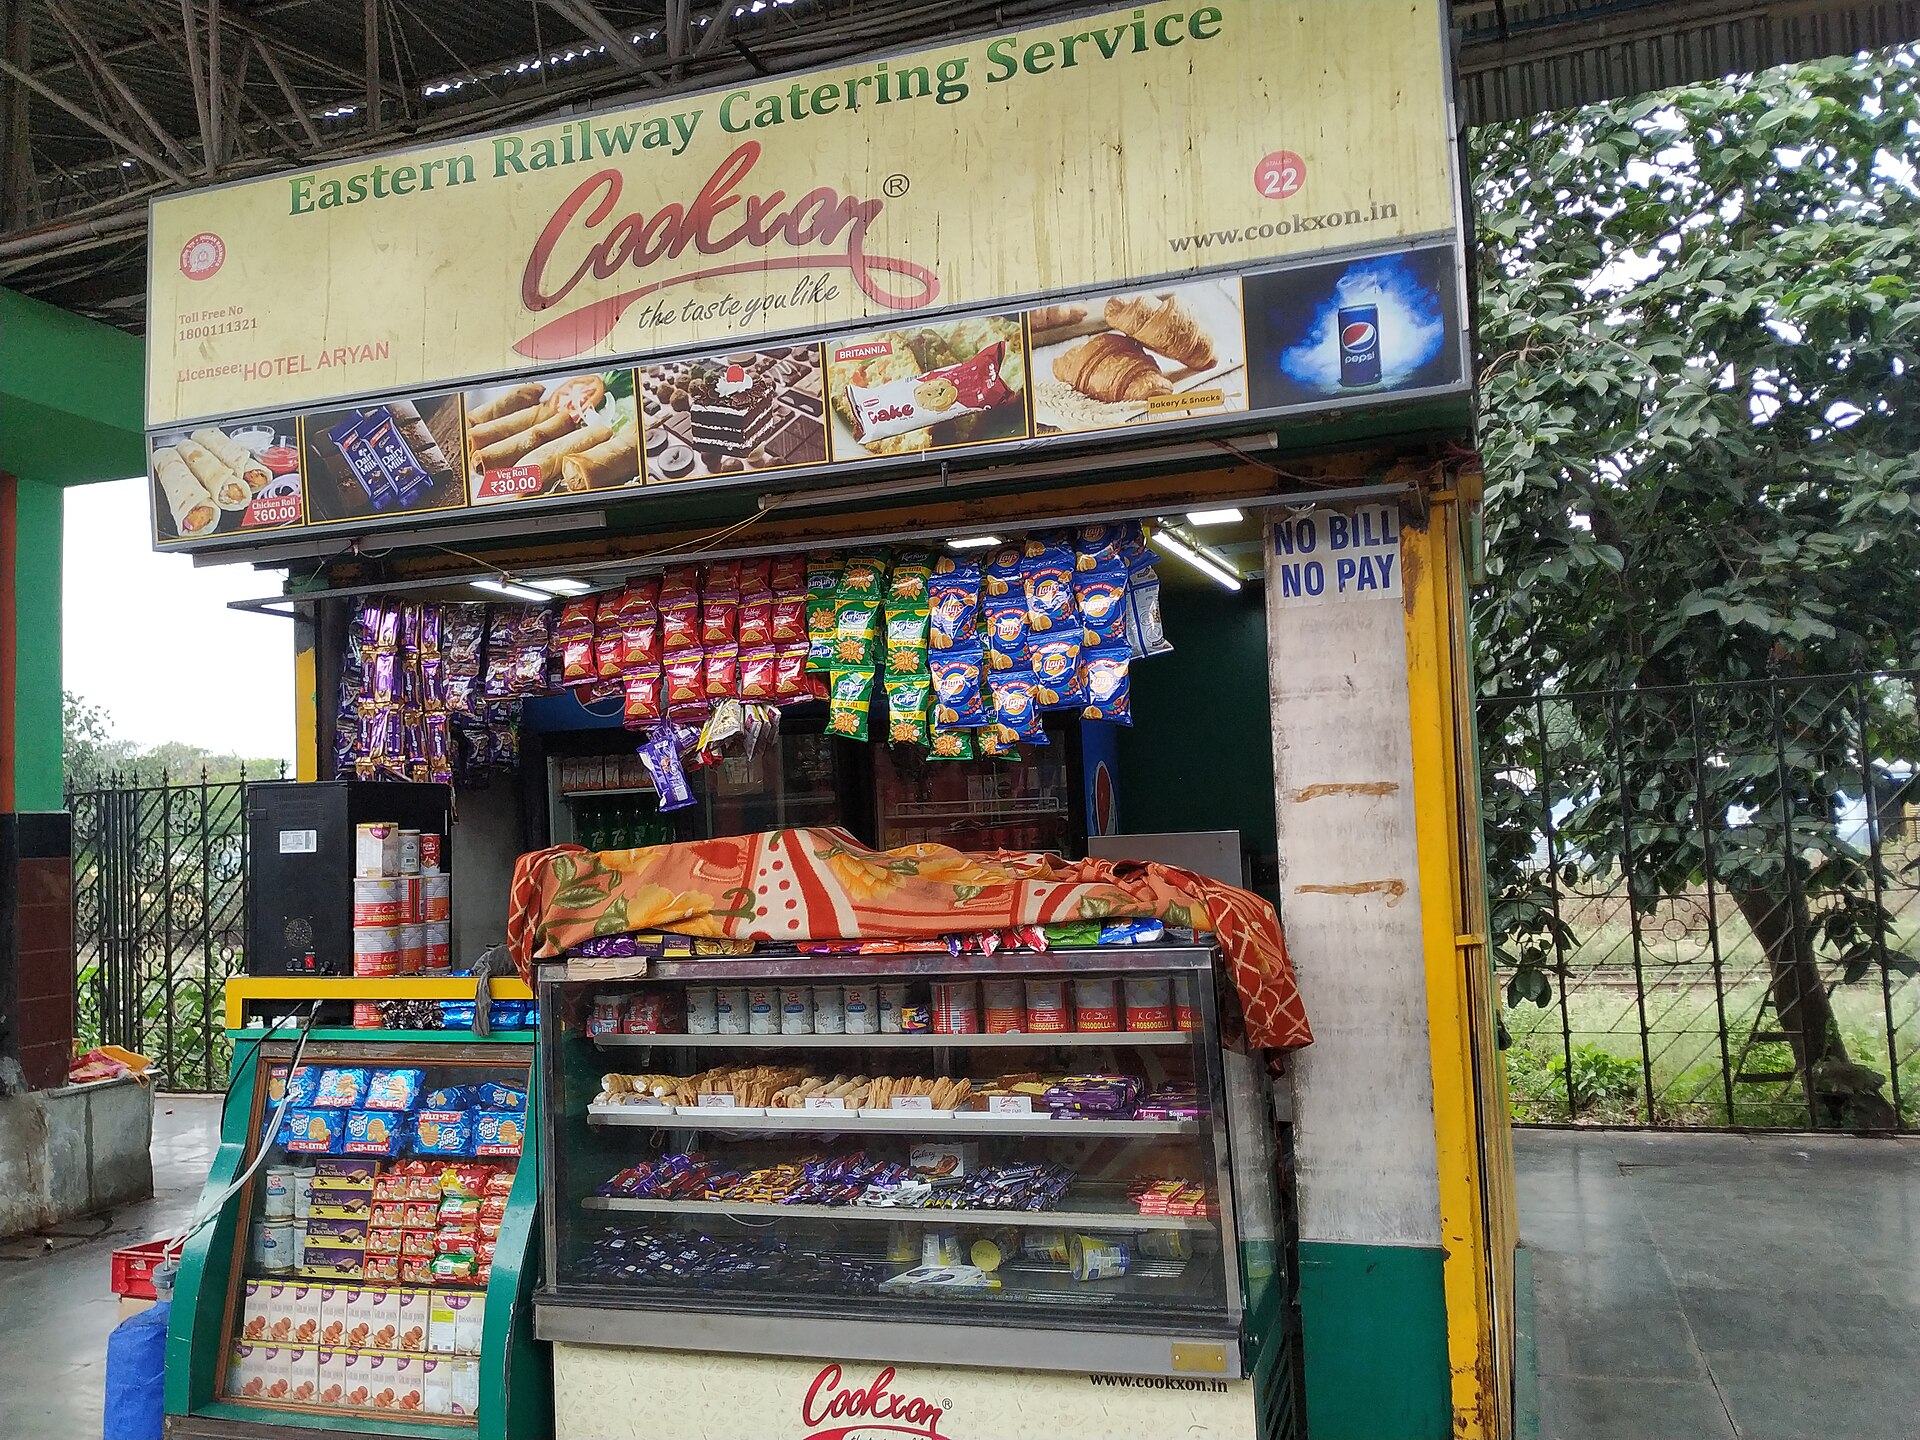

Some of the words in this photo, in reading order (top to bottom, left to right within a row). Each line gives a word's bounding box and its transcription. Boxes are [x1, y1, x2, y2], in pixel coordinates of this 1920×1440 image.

[289, 154, 476, 216] Eastern
[493, 110, 704, 177] Railway
[719, 57, 969, 134] Catering
[987, 5, 1223, 83] Service
[1264, 168, 1298, 194] 22
[522, 140, 884, 312] Cookxon
[1168, 201, 1399, 253] www.cookxon.in
[639, 299, 675, 329] the
[682, 299, 740, 325] taste
[740, 293, 787, 327] you
[790, 273, 841, 311] like
[179, 311, 199, 325] Toll
[202, 308, 226, 321] Free
[228, 305, 244, 317] No
[179, 318, 258, 341] 1800111321
[177, 363, 242, 383] Licensee:
[243, 355, 312, 381] HOTEL
[316, 341, 390, 370] ARYAN
[839, 345, 888, 360] BRITANNIA
[1344, 351, 1375, 365] pepsi
[1150, 400, 1180, 409] Bakery
[1189, 394, 1220, 404] Snacks
[354, 452, 372, 469] Dair
[381, 446, 404, 466] Dairy
[386, 455, 407, 473] Milk
[496, 470, 512, 480] Veg
[512, 468, 528, 477] Roll
[252, 500, 280, 510] Chicken
[281, 498, 296, 508] Roll
[1273, 518, 1316, 556] NO
[1329, 511, 1399, 550] BILL
[1281, 561, 1325, 598] NO
[1337, 554, 1395, 593] PAY
[290, 1116, 310, 1128] Good
[348, 1116, 368, 1129] Good
[478, 1119, 499, 1131] Good
[1088, 1373, 1229, 1393] www.cookxon.in
[802, 1363, 943, 1428] Cookxon
